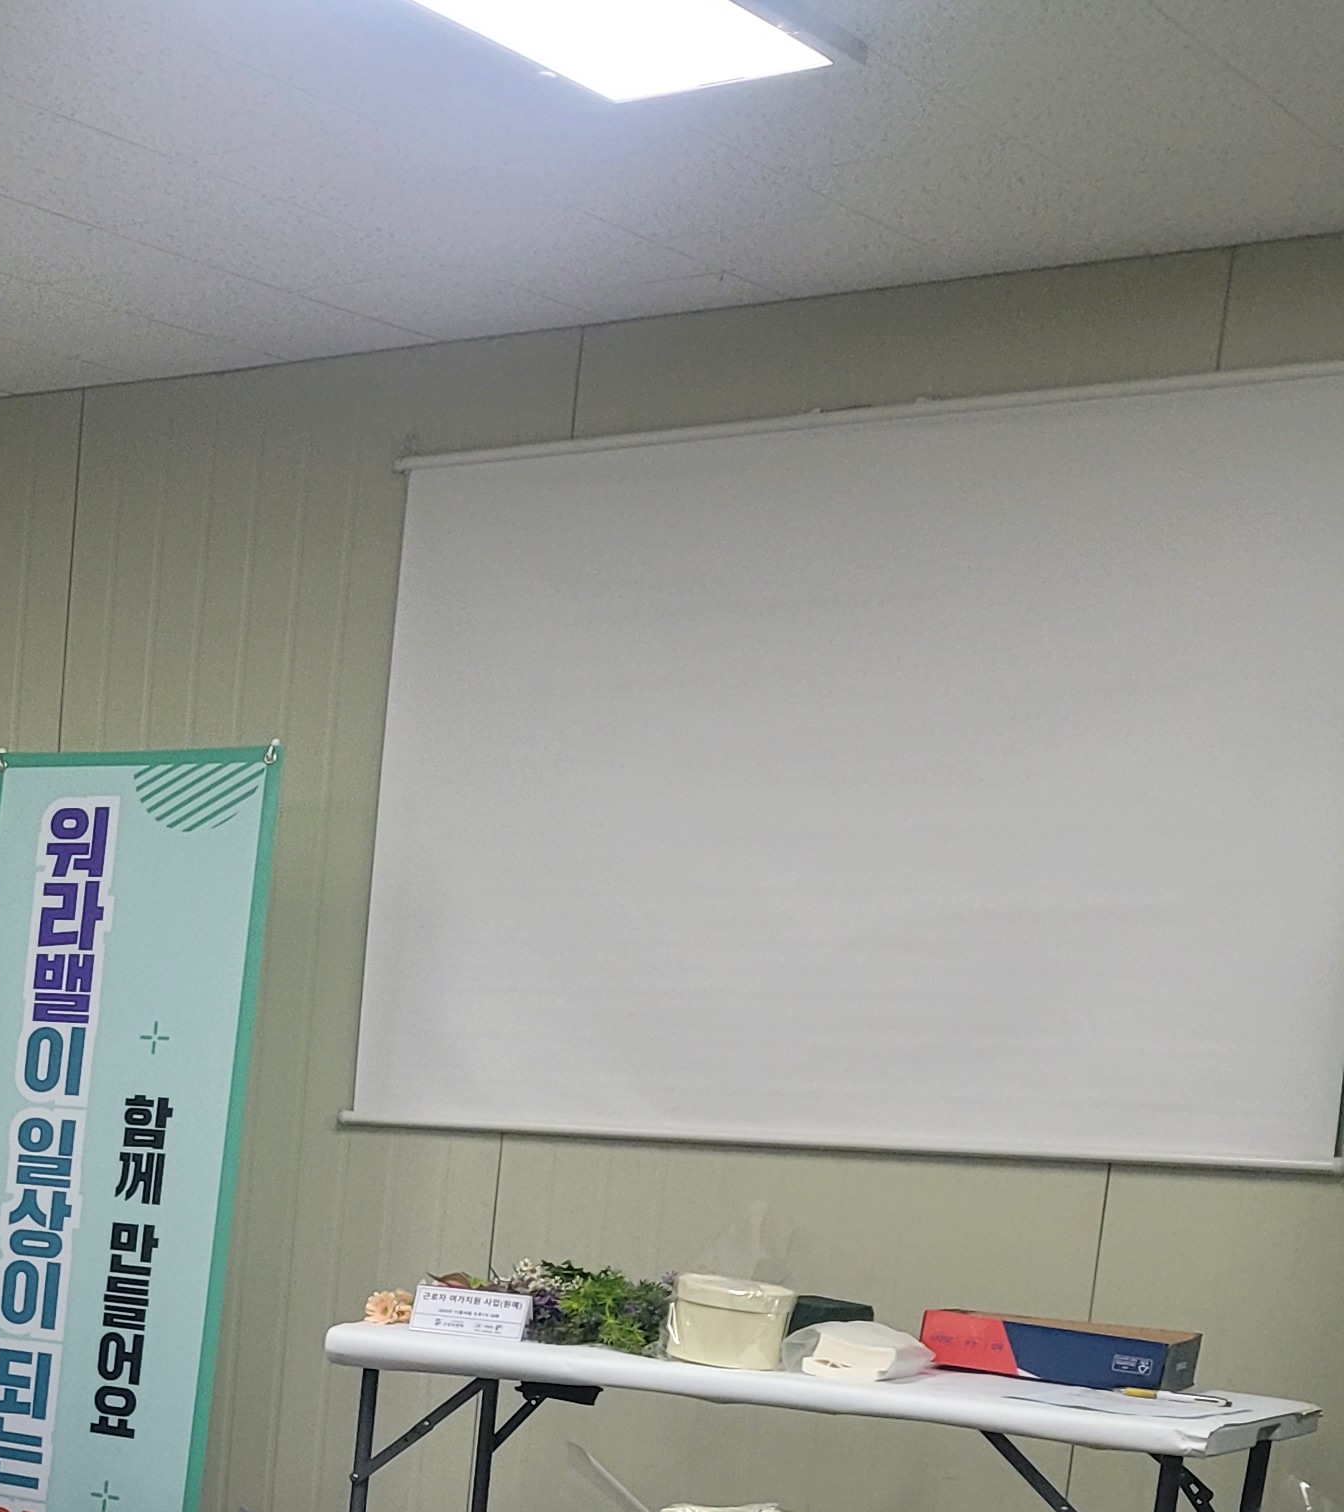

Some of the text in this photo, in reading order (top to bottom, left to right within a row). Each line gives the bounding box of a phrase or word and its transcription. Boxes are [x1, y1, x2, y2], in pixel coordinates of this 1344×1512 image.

[22, 805, 111, 1098] 워라밸이
[1, 1116, 78, 1333] 일상이
[89, 1095, 174, 1440] 함께 만들어요
[423, 1291, 447, 1302] 근로자
[449, 1294, 482, 1307] 여가지원
